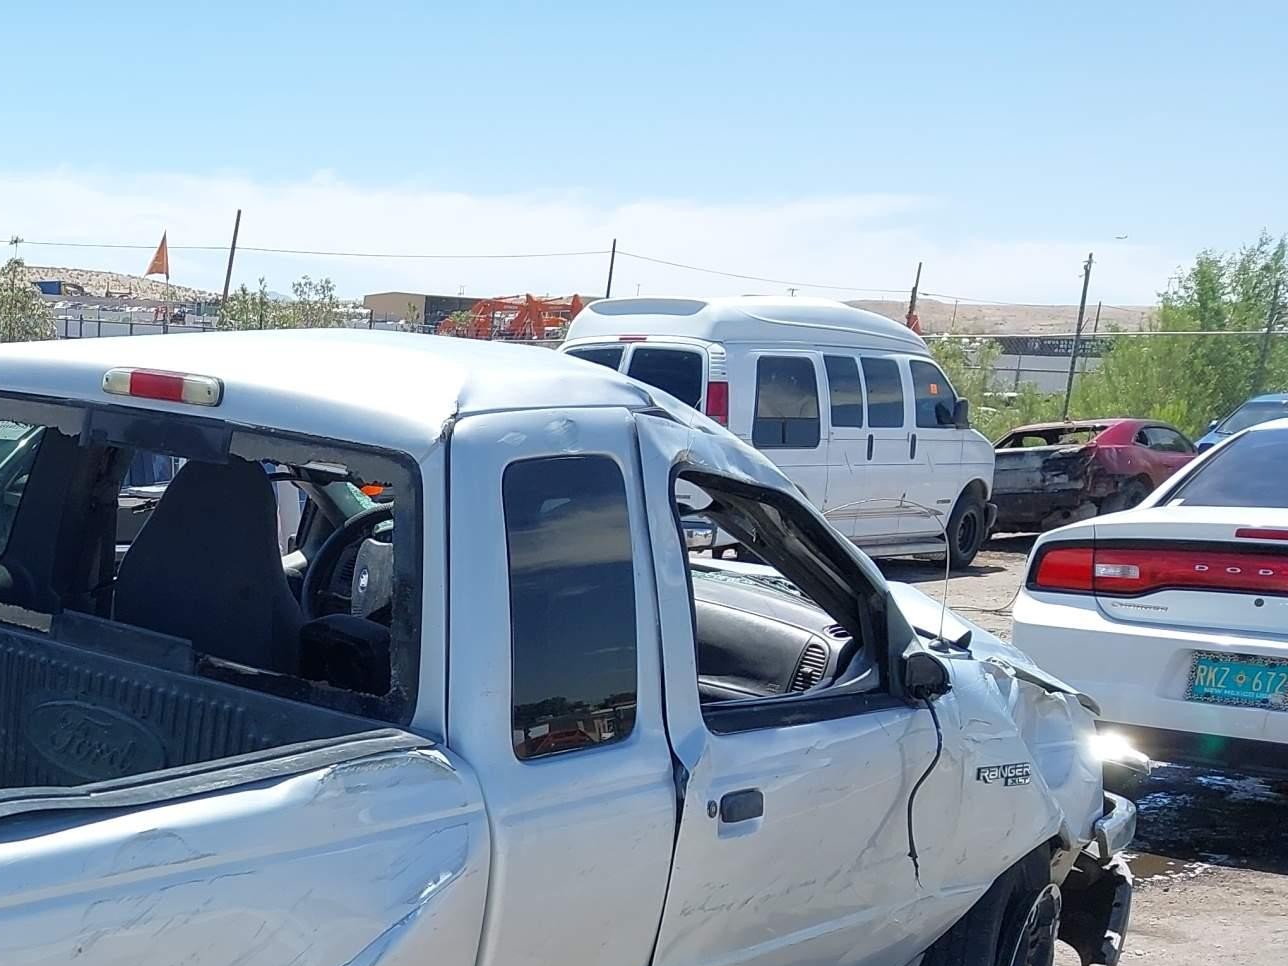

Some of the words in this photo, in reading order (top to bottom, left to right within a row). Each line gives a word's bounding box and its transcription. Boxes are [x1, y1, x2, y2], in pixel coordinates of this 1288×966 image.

[1195, 665, 1230, 688] RKZ
[1253, 671, 1288, 694] 672
[49, 710, 136, 773] Ford
[976, 763, 1031, 783] RANGER
